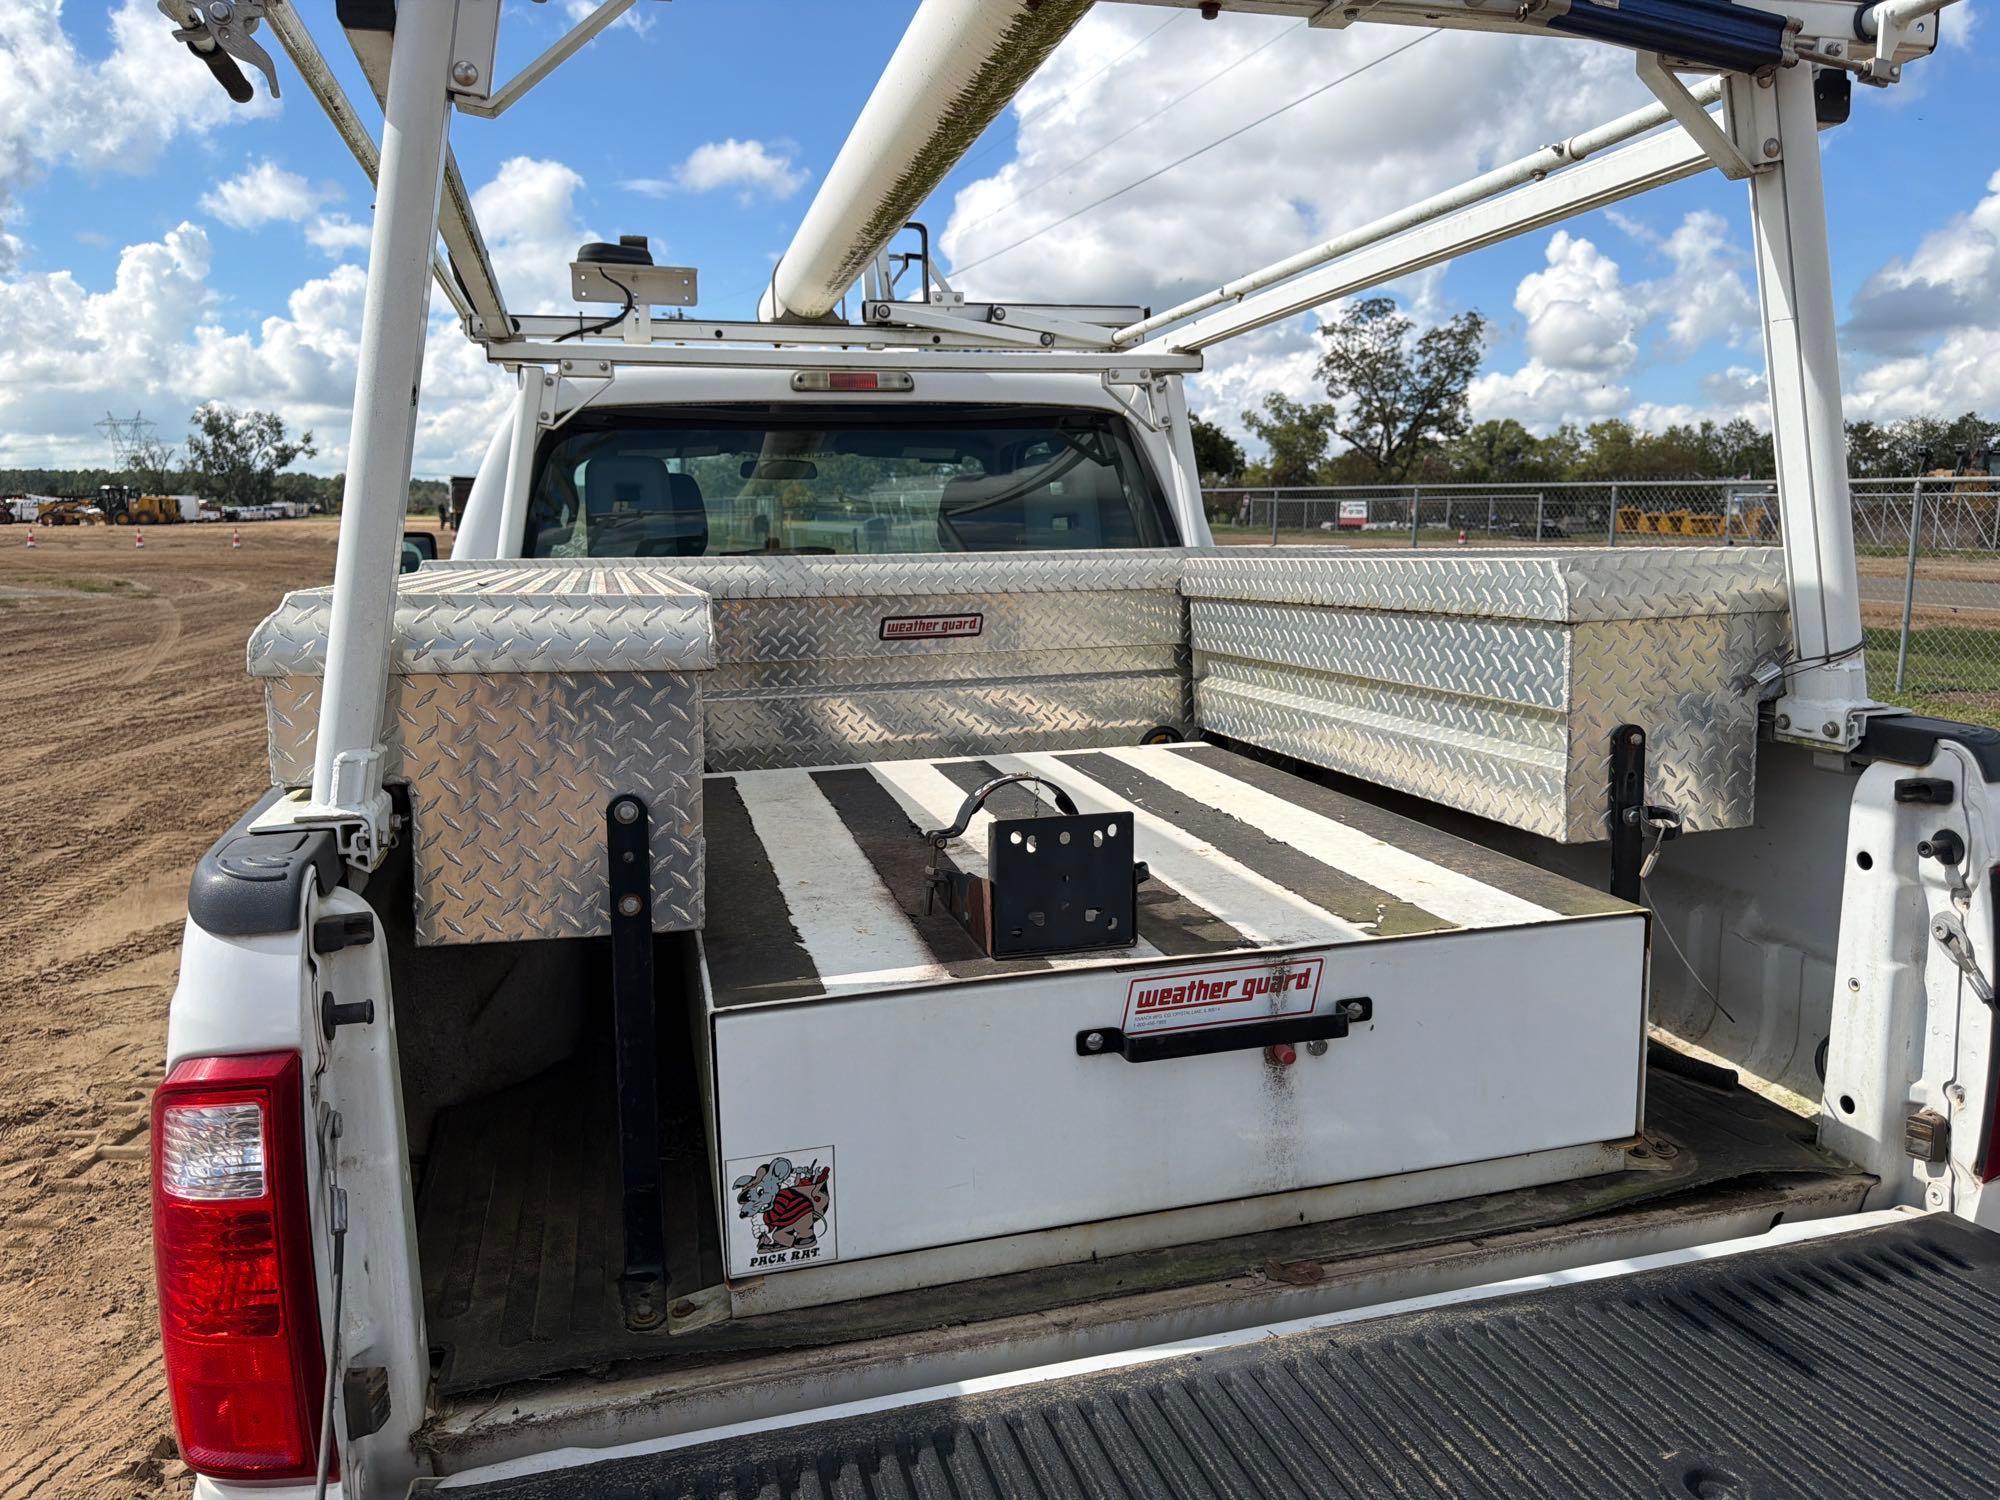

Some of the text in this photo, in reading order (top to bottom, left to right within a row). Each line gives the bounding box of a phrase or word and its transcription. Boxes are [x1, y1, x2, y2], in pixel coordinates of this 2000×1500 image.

[886, 618, 978, 633] weather guard
[1136, 967, 1313, 1009] weather guard
[749, 1252, 787, 1267] PACK
[790, 1247, 820, 1261] RAT
